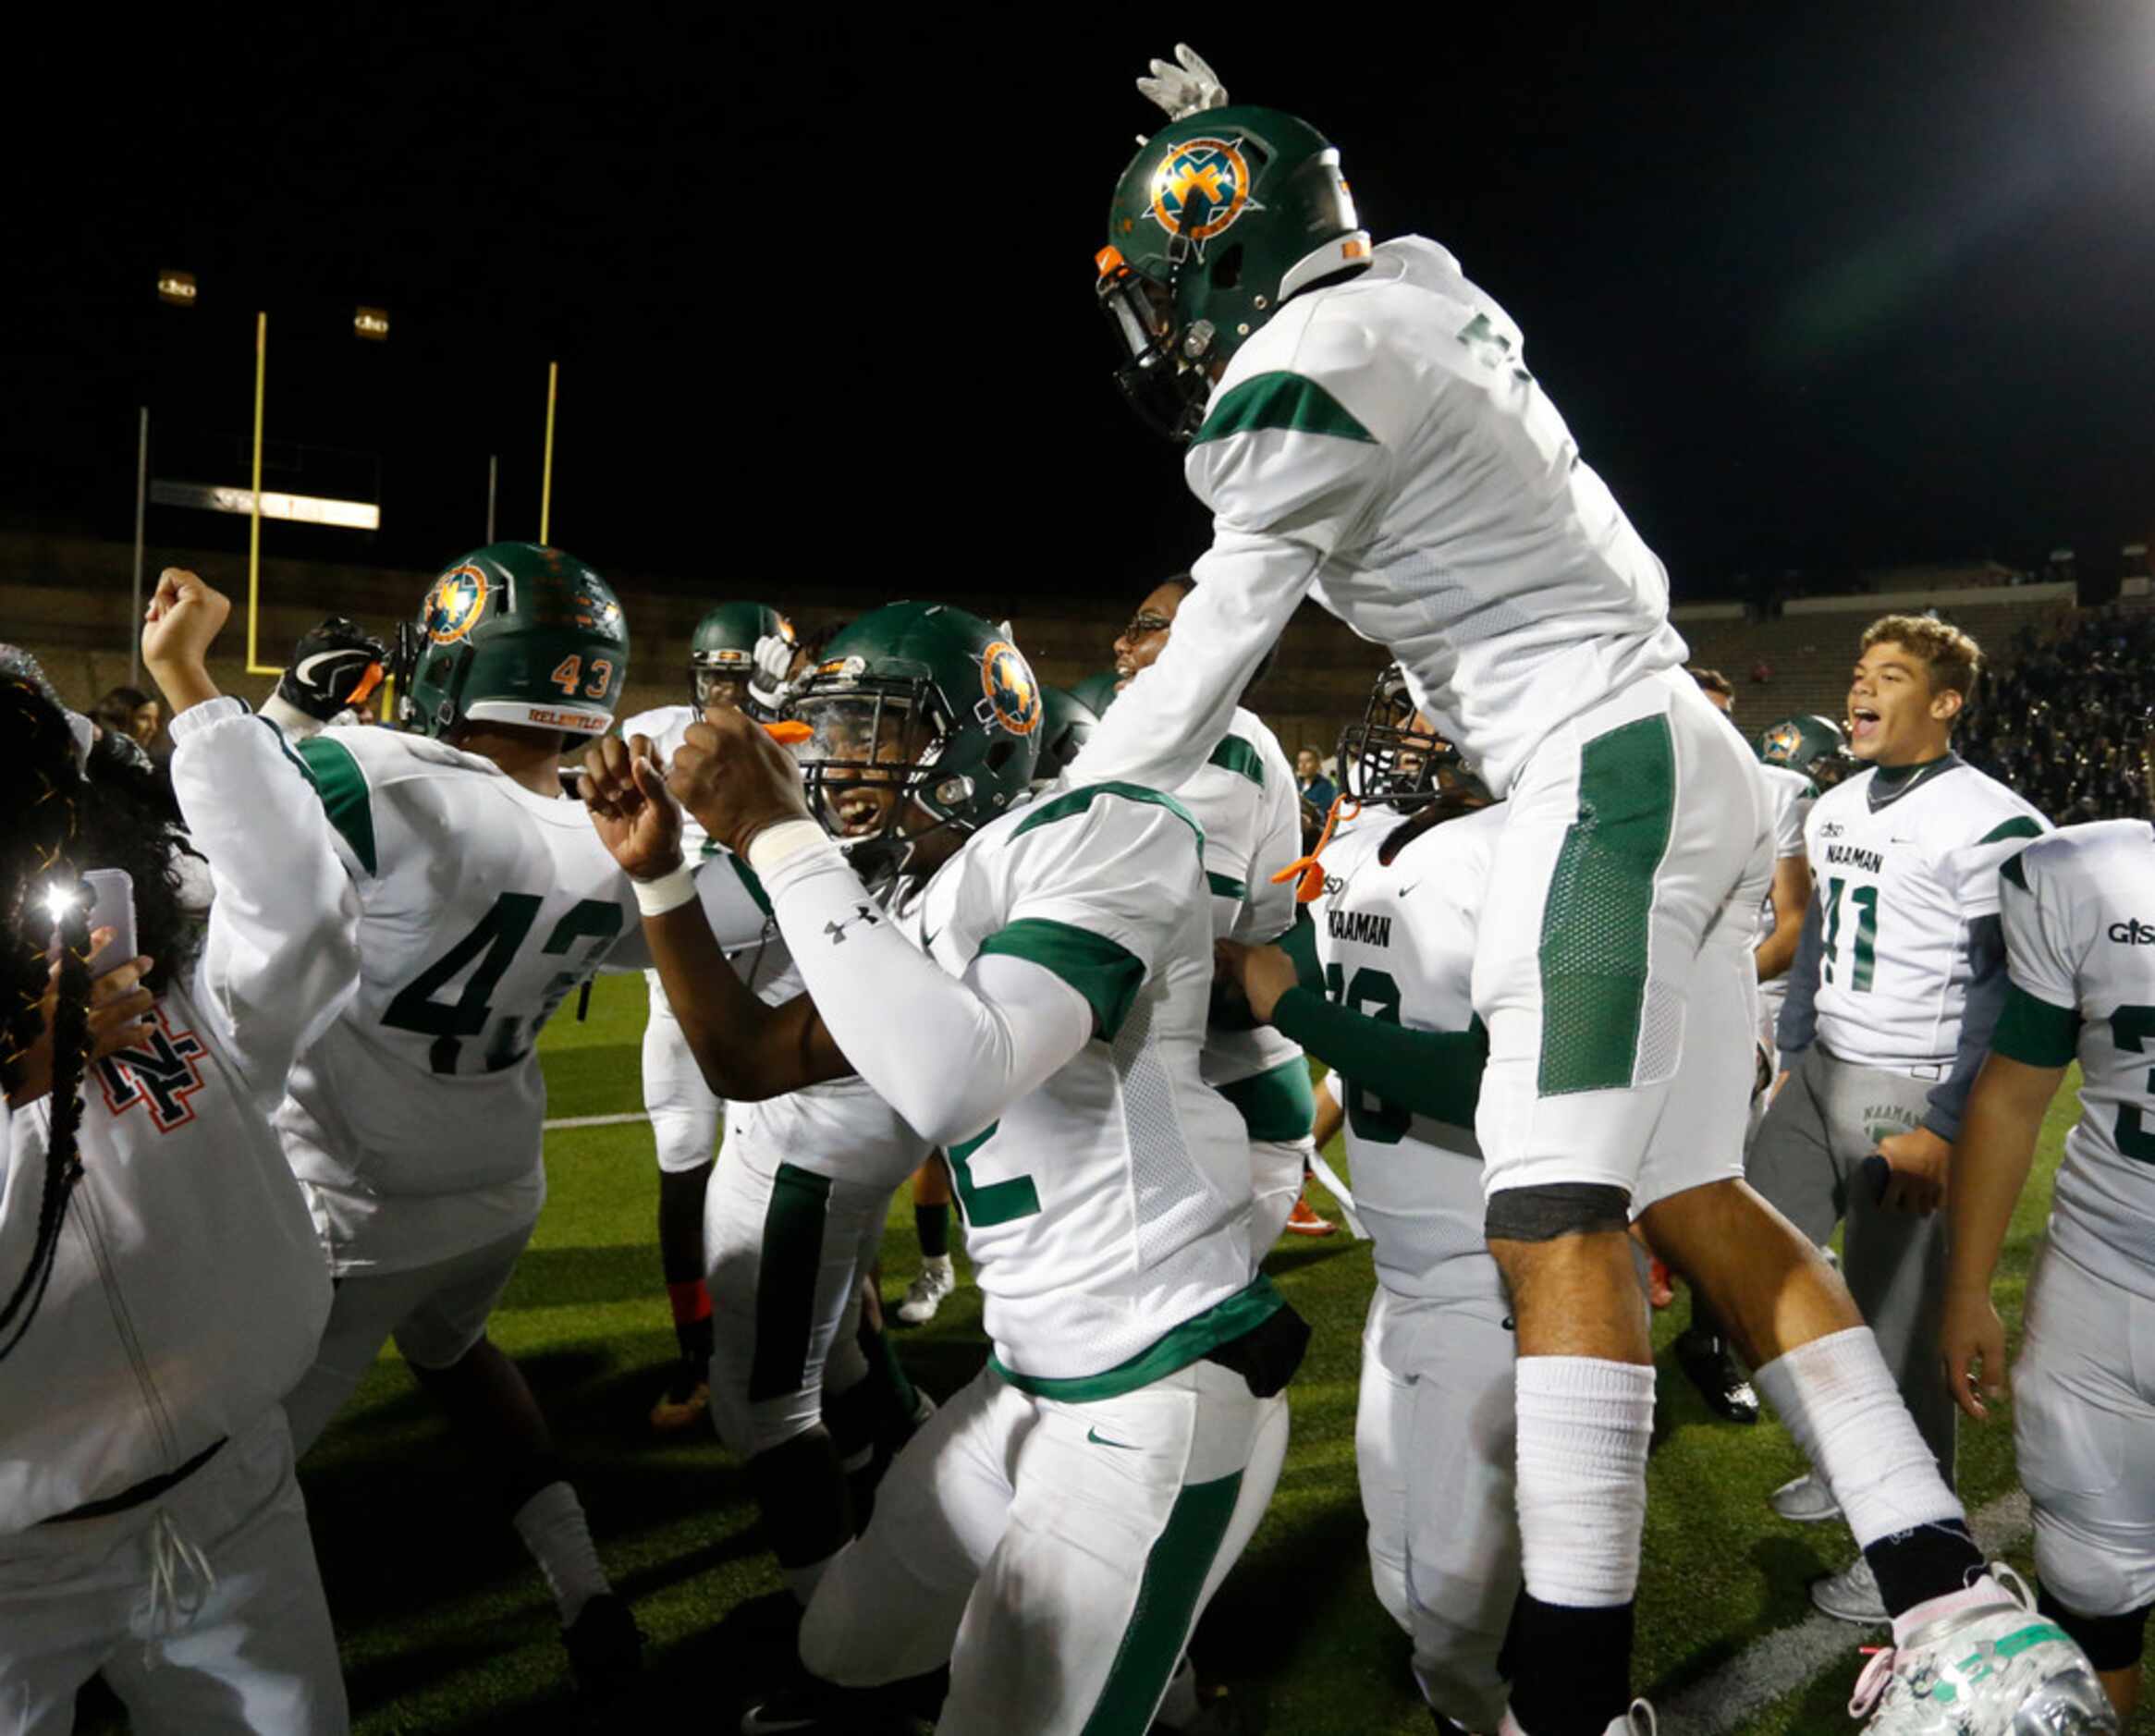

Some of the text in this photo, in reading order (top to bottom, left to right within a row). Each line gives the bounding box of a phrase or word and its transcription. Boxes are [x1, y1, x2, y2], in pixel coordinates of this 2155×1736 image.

[551, 654, 612, 698] 43
[1826, 844, 1884, 874] NAAMAN
[1329, 910, 1391, 948] NAAMAN
[2108, 917, 2155, 946] GIS
